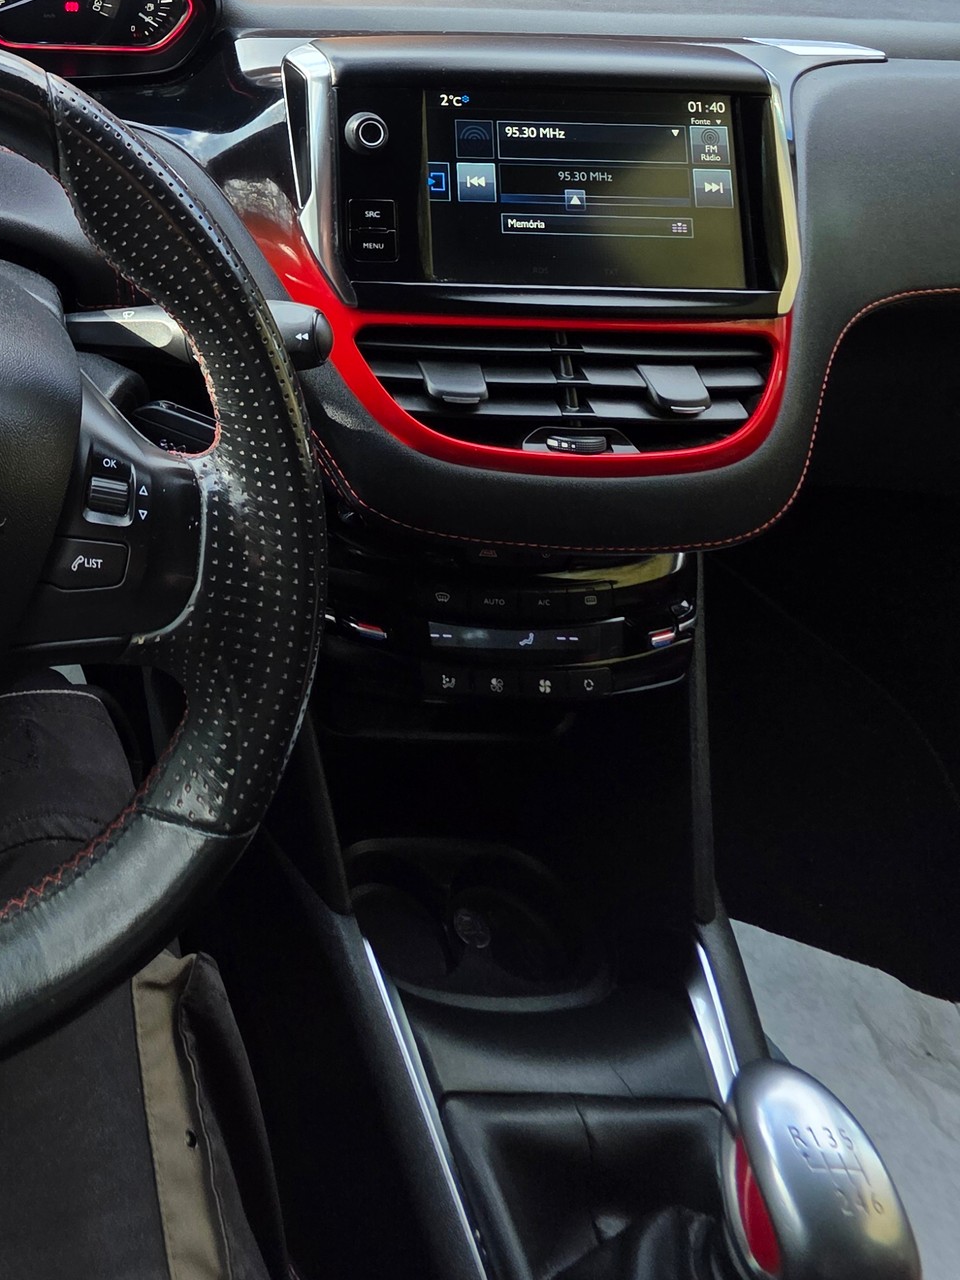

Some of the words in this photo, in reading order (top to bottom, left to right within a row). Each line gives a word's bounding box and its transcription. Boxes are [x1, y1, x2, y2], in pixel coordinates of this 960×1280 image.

[691, 117, 711, 126] Fonte
[505, 127, 537, 139] 95.30
[540, 128, 565, 139] MHz
[705, 145, 717, 153] FM
[701, 154, 721, 162] Rádio
[558, 171, 587, 181] 95.30
[590, 172, 613, 182] MHz
[507, 219, 545, 229] Memória
[103, 458, 117, 468] OK
[84, 559, 103, 568] LIST
[484, 598, 505, 606] AUTO
